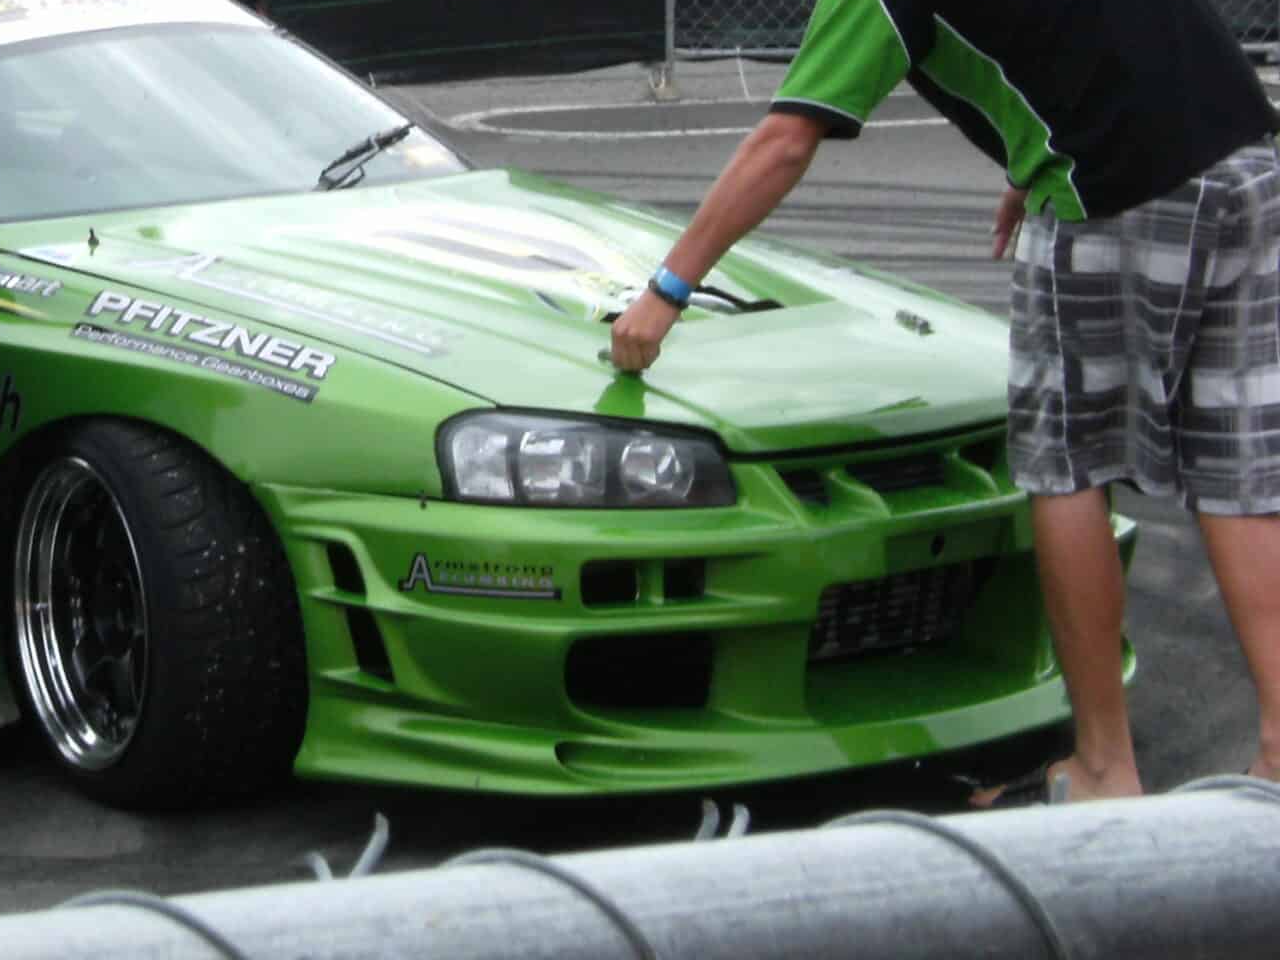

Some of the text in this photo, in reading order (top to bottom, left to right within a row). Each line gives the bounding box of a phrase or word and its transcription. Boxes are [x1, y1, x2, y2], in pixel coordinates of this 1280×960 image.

[73, 323, 311, 399] Performance Gearboxes
[86, 290, 336, 380] PFITZNER
